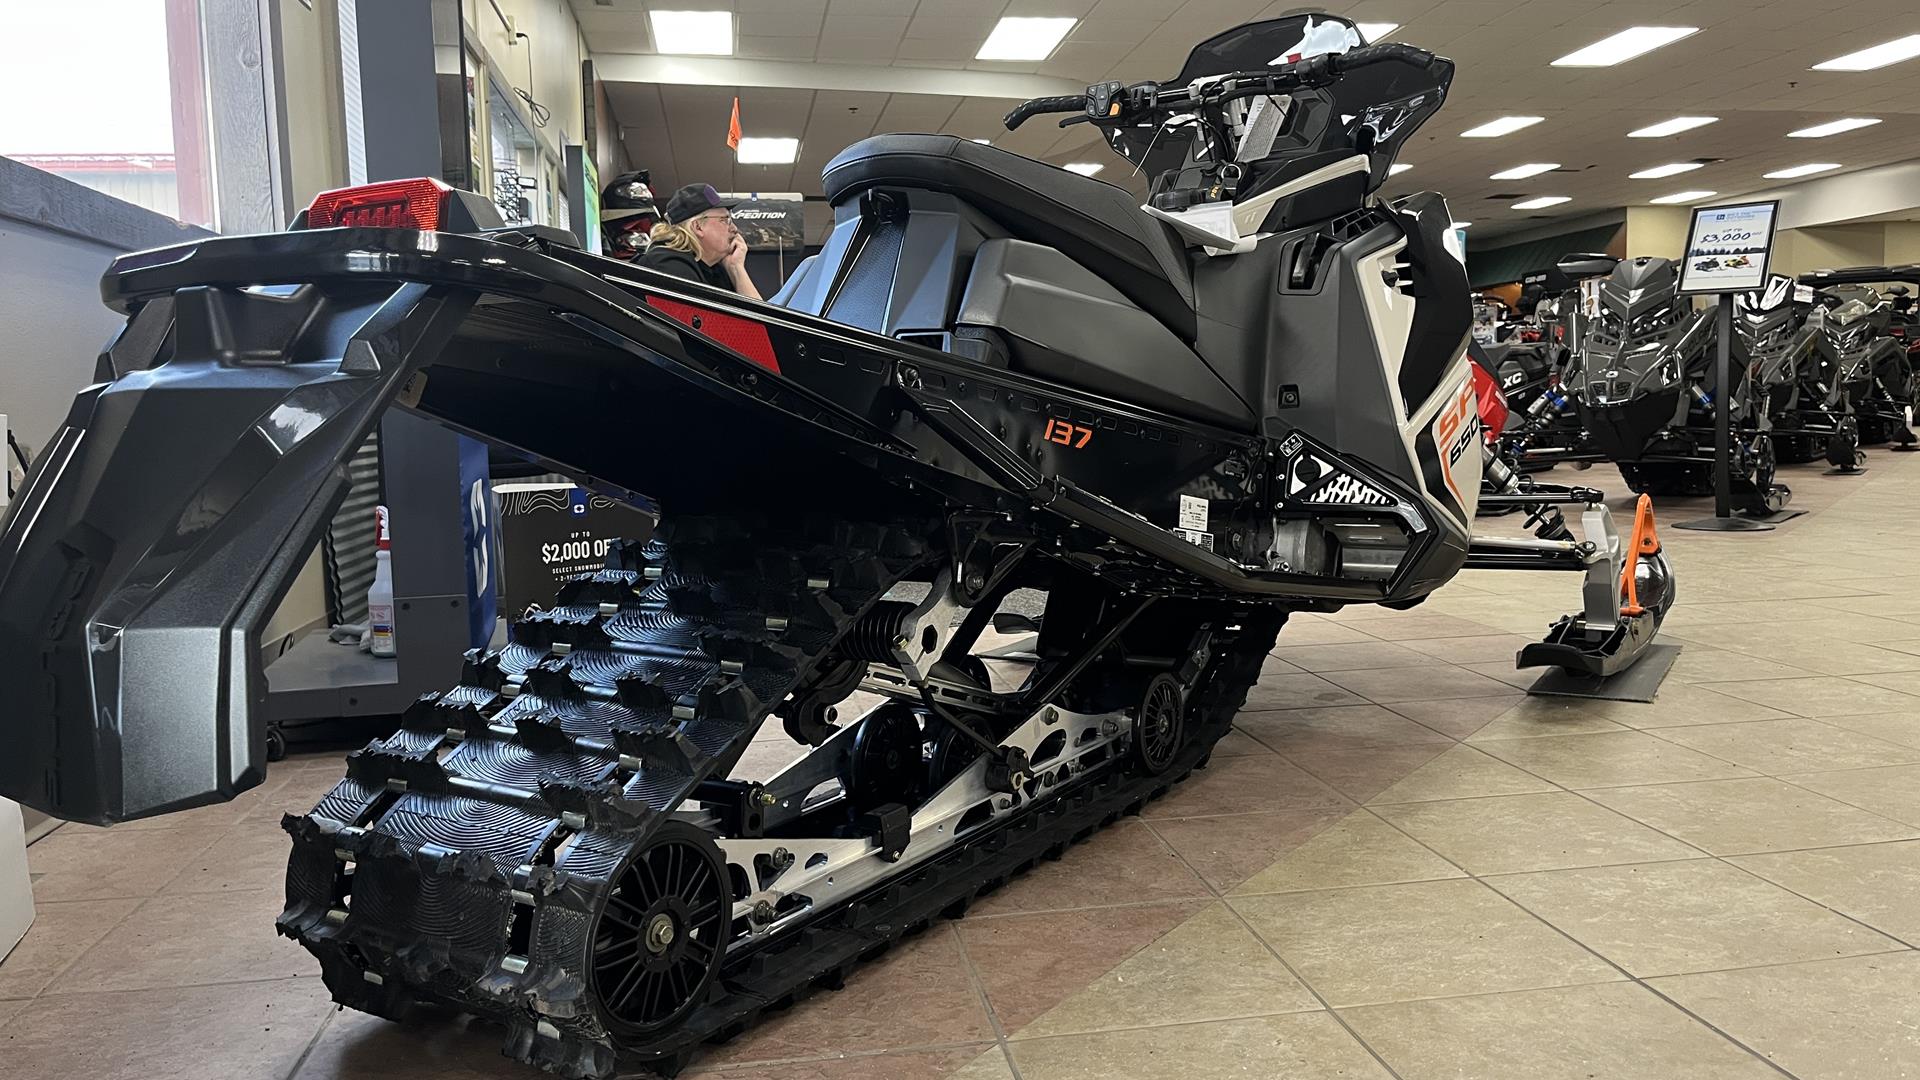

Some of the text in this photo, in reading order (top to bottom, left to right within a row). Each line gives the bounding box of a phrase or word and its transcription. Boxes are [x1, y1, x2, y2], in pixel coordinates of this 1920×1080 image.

[1700, 232, 1751, 243] $3,000
[1502, 372, 1522, 389] XC
[1044, 419, 1092, 448] 137
[1449, 413, 1479, 468] 650
[542, 539, 612, 564] $2,000 OF
